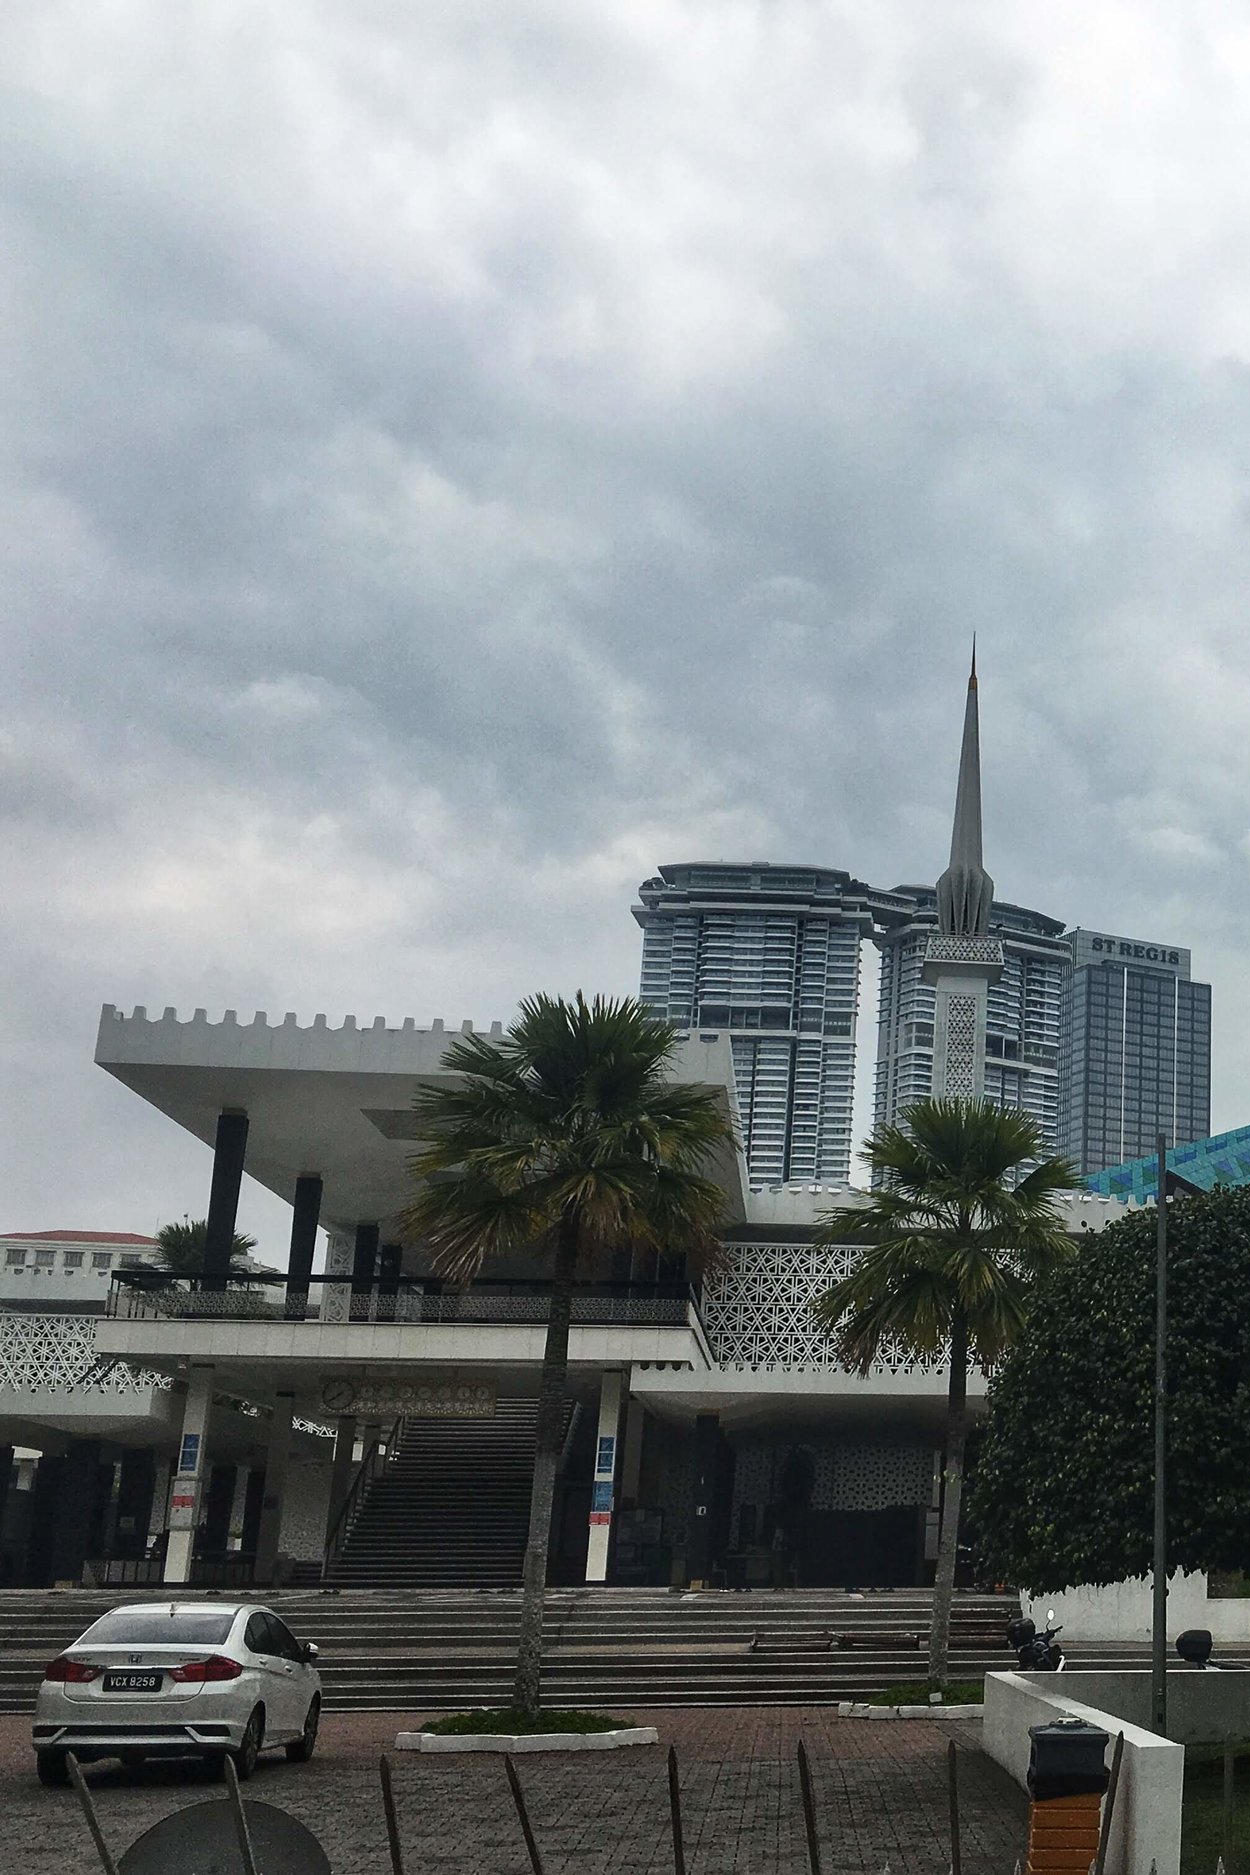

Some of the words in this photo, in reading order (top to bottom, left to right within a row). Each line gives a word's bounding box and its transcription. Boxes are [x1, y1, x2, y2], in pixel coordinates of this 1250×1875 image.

[1092, 937, 1115, 953] ST
[1119, 942, 1179, 964] REGIS
[110, 1676, 128, 1687] VCX
[130, 1676, 156, 1687] 8258
